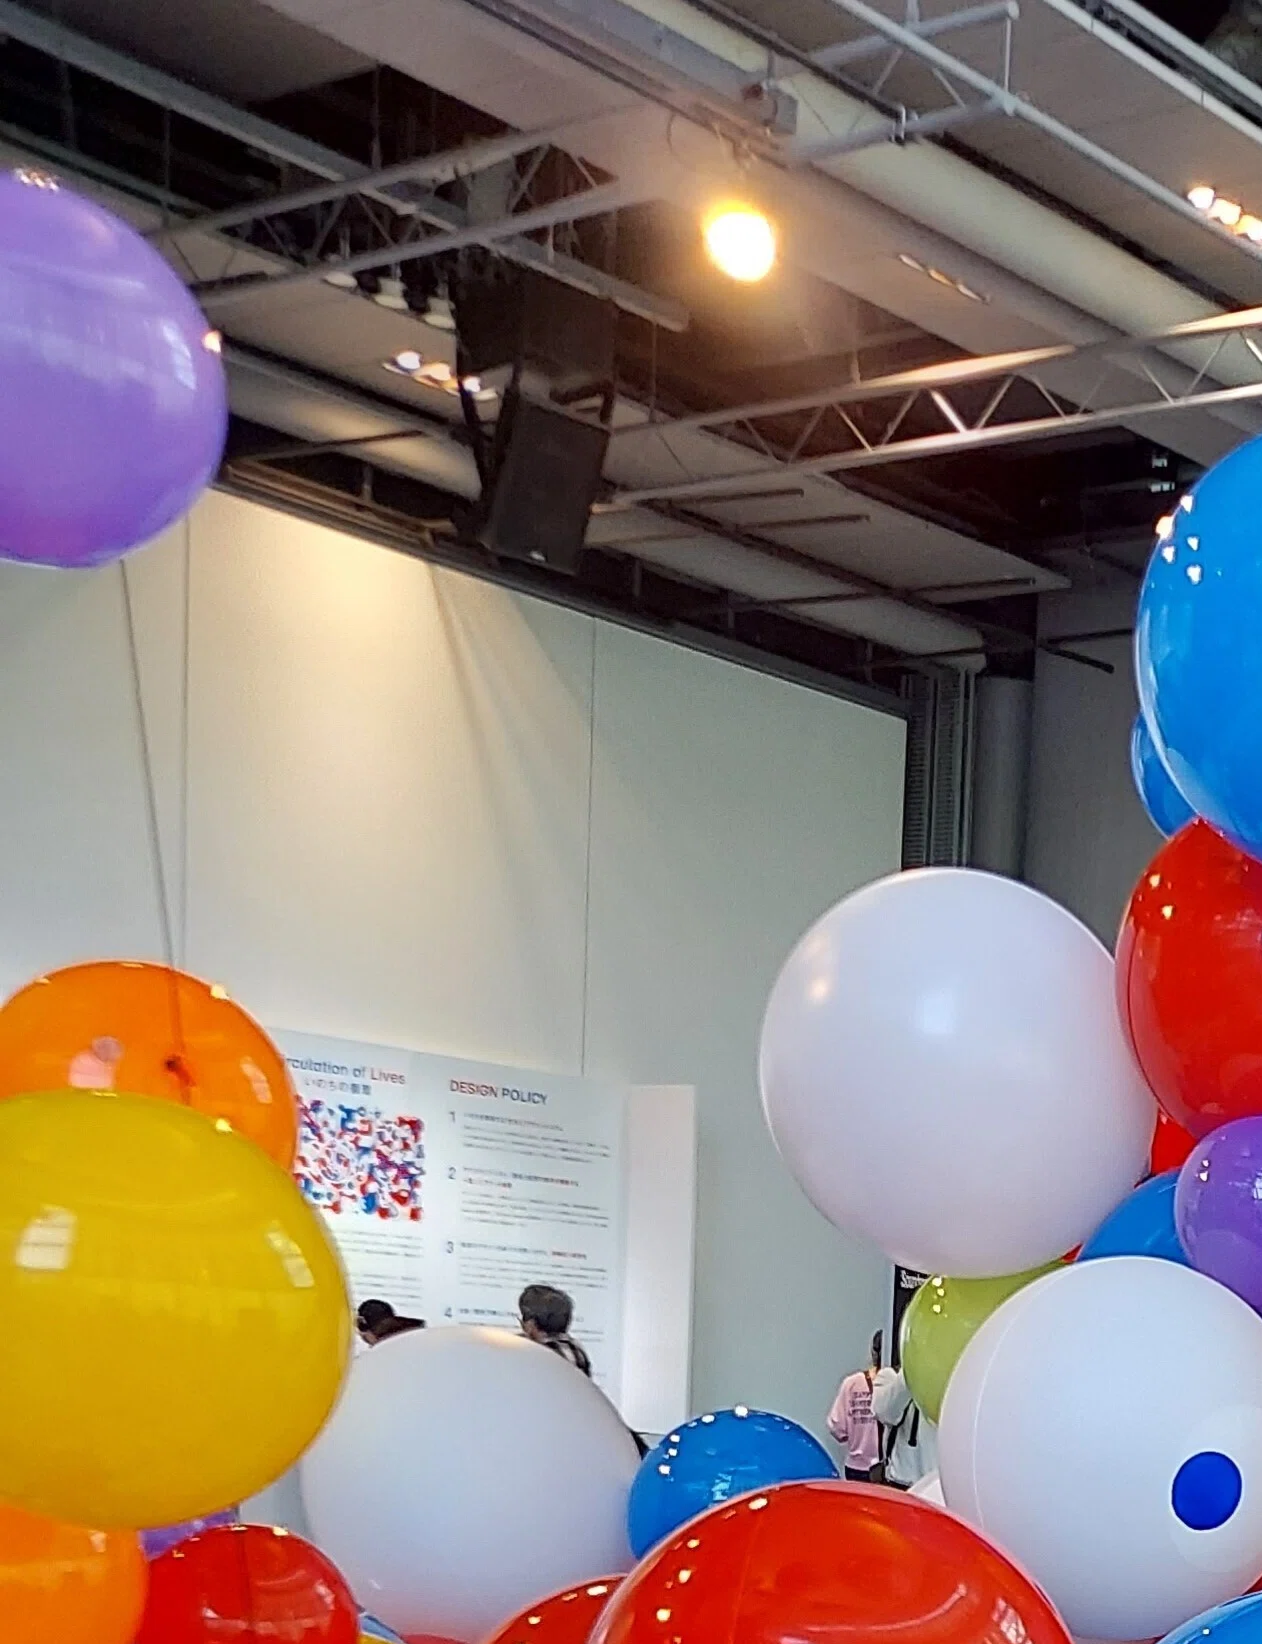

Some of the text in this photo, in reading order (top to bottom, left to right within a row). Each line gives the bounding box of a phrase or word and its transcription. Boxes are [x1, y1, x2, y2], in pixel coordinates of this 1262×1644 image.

[370, 1067, 407, 1085] Lives
[449, 1079, 548, 1105] DESIGN POLICY
